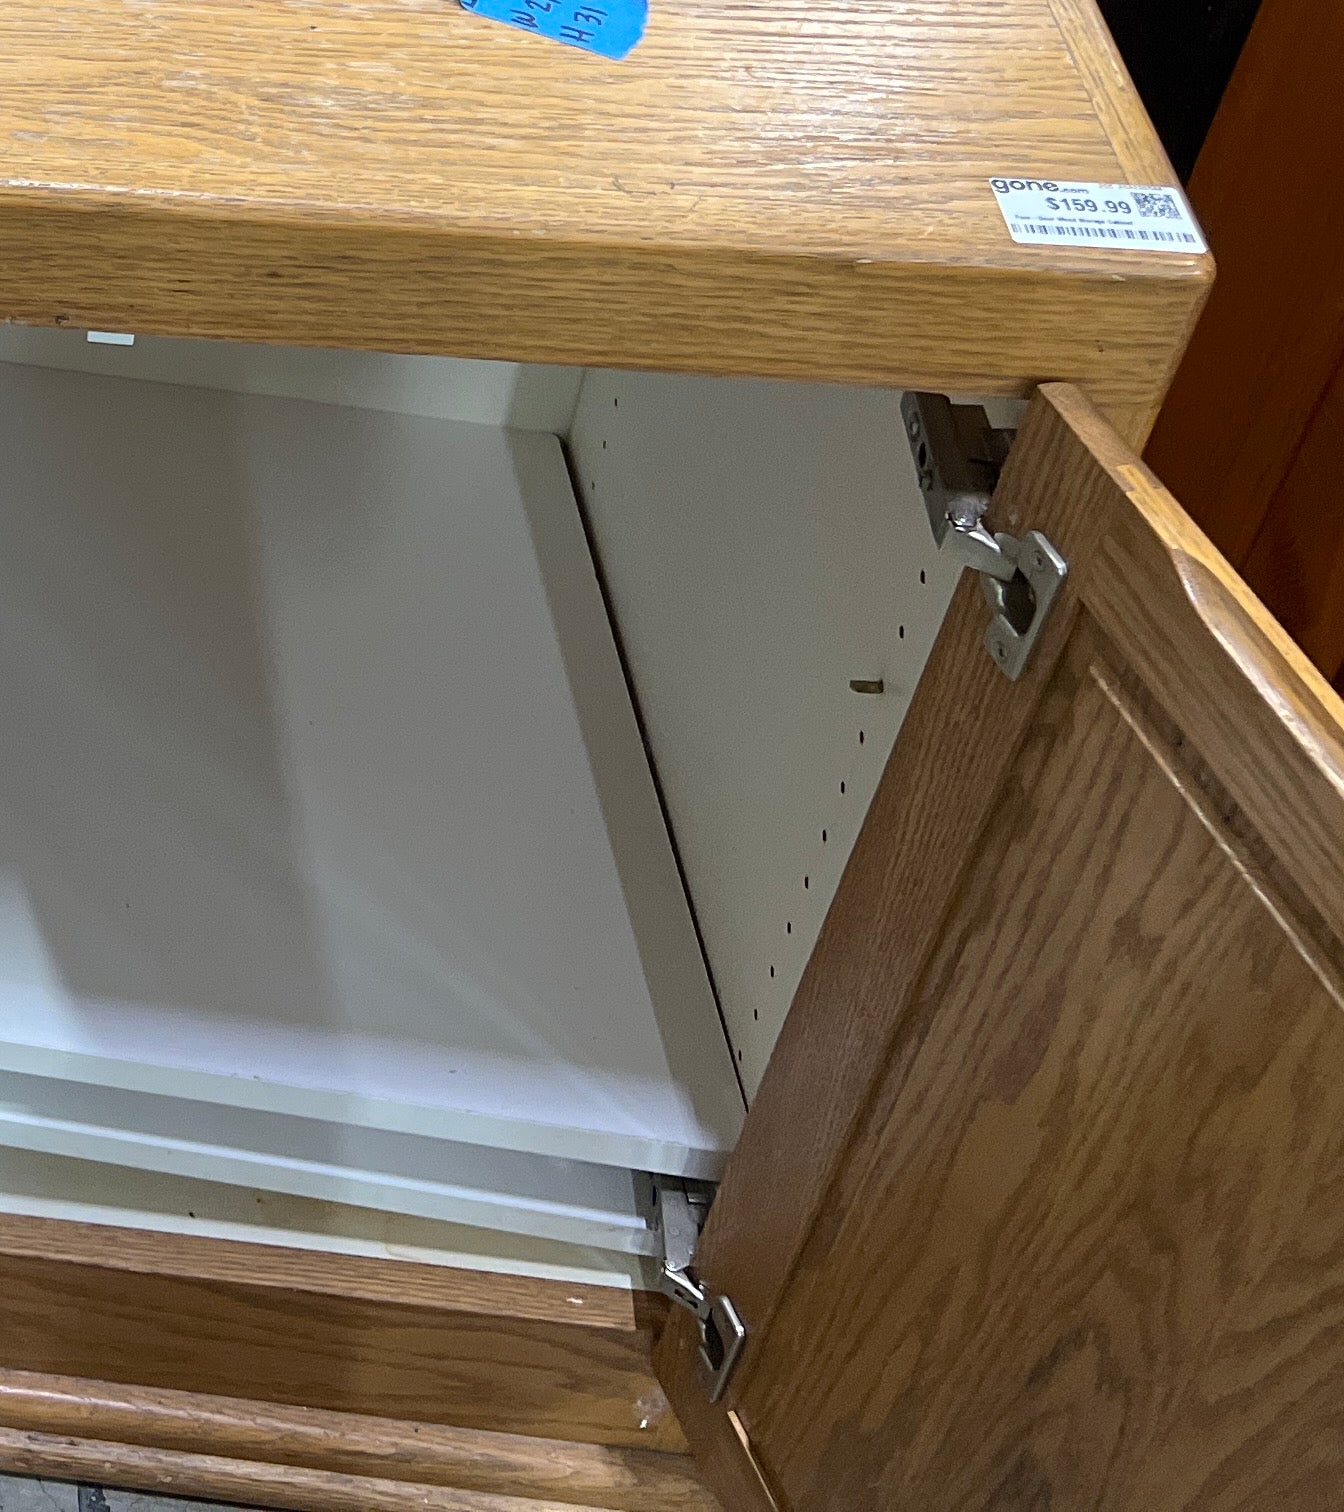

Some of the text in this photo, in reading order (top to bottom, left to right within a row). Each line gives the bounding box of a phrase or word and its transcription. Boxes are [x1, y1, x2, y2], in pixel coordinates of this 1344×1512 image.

[510, 9, 538, 28] W
[560, 25, 595, 43] H
[1045, 197, 1132, 214] $159.99
